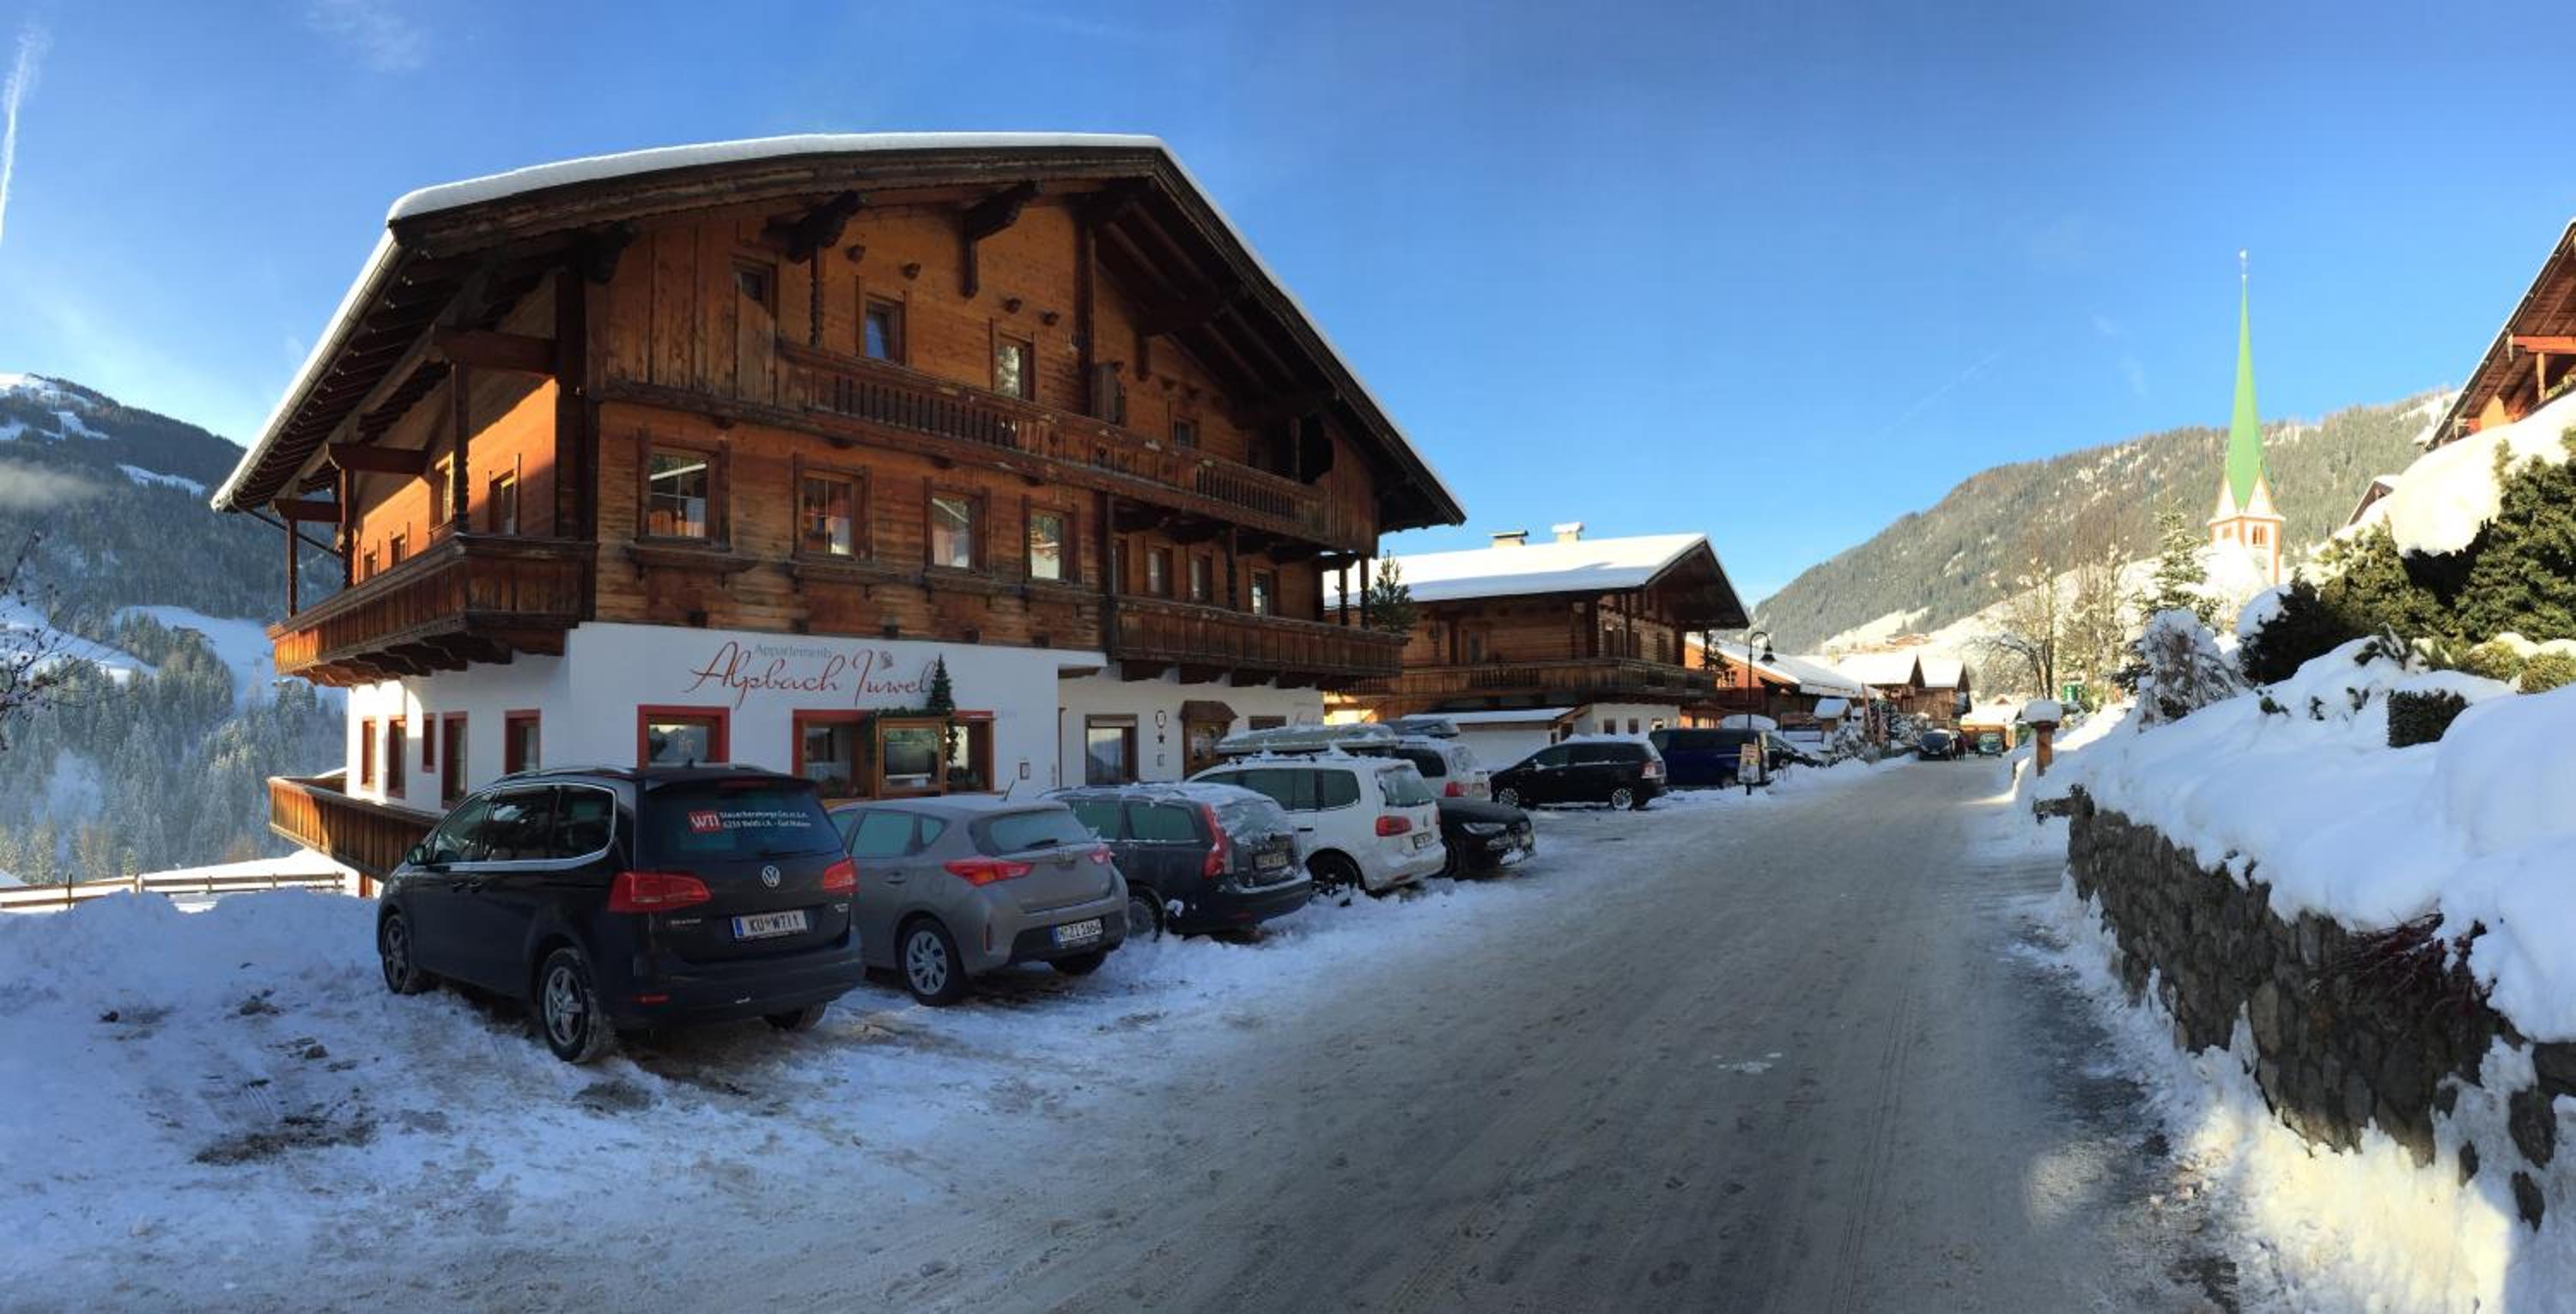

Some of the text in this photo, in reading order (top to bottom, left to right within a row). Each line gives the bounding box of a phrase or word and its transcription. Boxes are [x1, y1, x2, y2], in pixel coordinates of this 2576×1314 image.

[756, 644, 831, 660] Appartements
[684, 641, 937, 710] Alpbach Juwel
